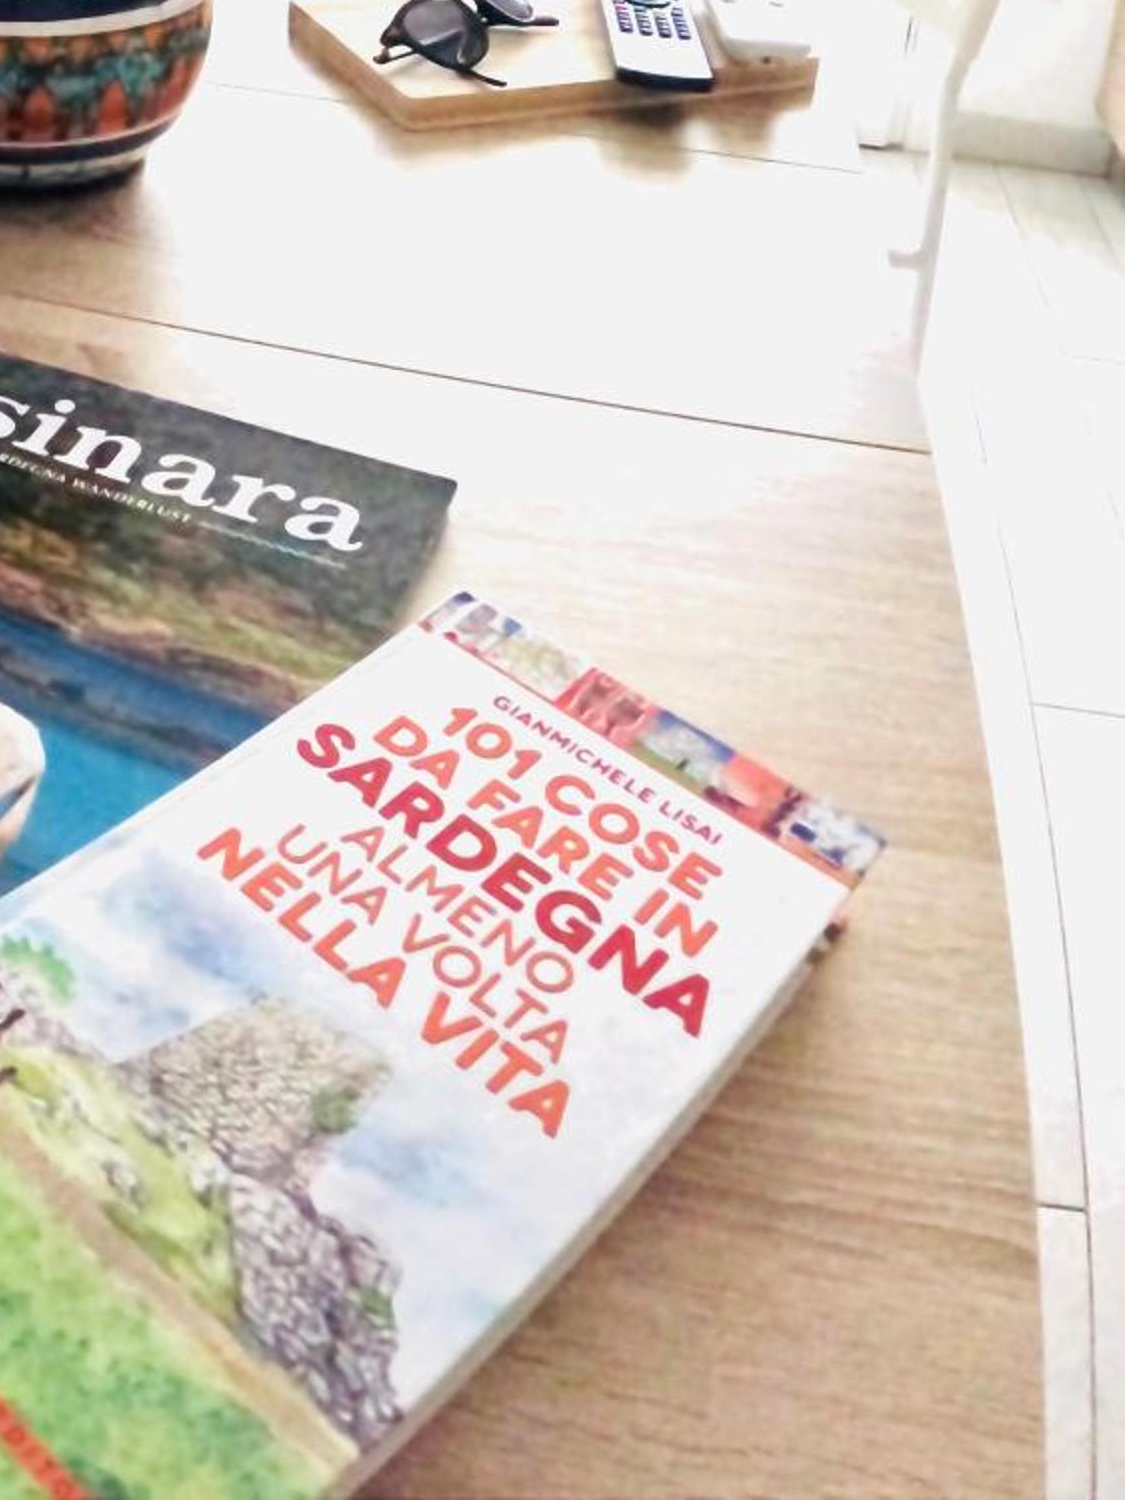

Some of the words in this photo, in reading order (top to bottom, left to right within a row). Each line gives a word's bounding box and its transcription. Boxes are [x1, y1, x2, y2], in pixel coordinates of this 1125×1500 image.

[296, 722, 712, 1038] SARDEGNA
[372, 715, 461, 790] DA
[466, 778, 634, 902] FARE
[633, 888, 719, 957] IN
[441, 706, 543, 780] 101
[543, 774, 724, 902] COSE
[492, 695, 655, 805] GIANMICHELE
[658, 800, 724, 846] LISAI
[196, 827, 408, 1010] NELLA
[419, 992, 573, 1139] VITA
[276, 824, 387, 925] UNA
[402, 913, 569, 1064] VOLTA
[341, 825, 575, 994] ALMENO
